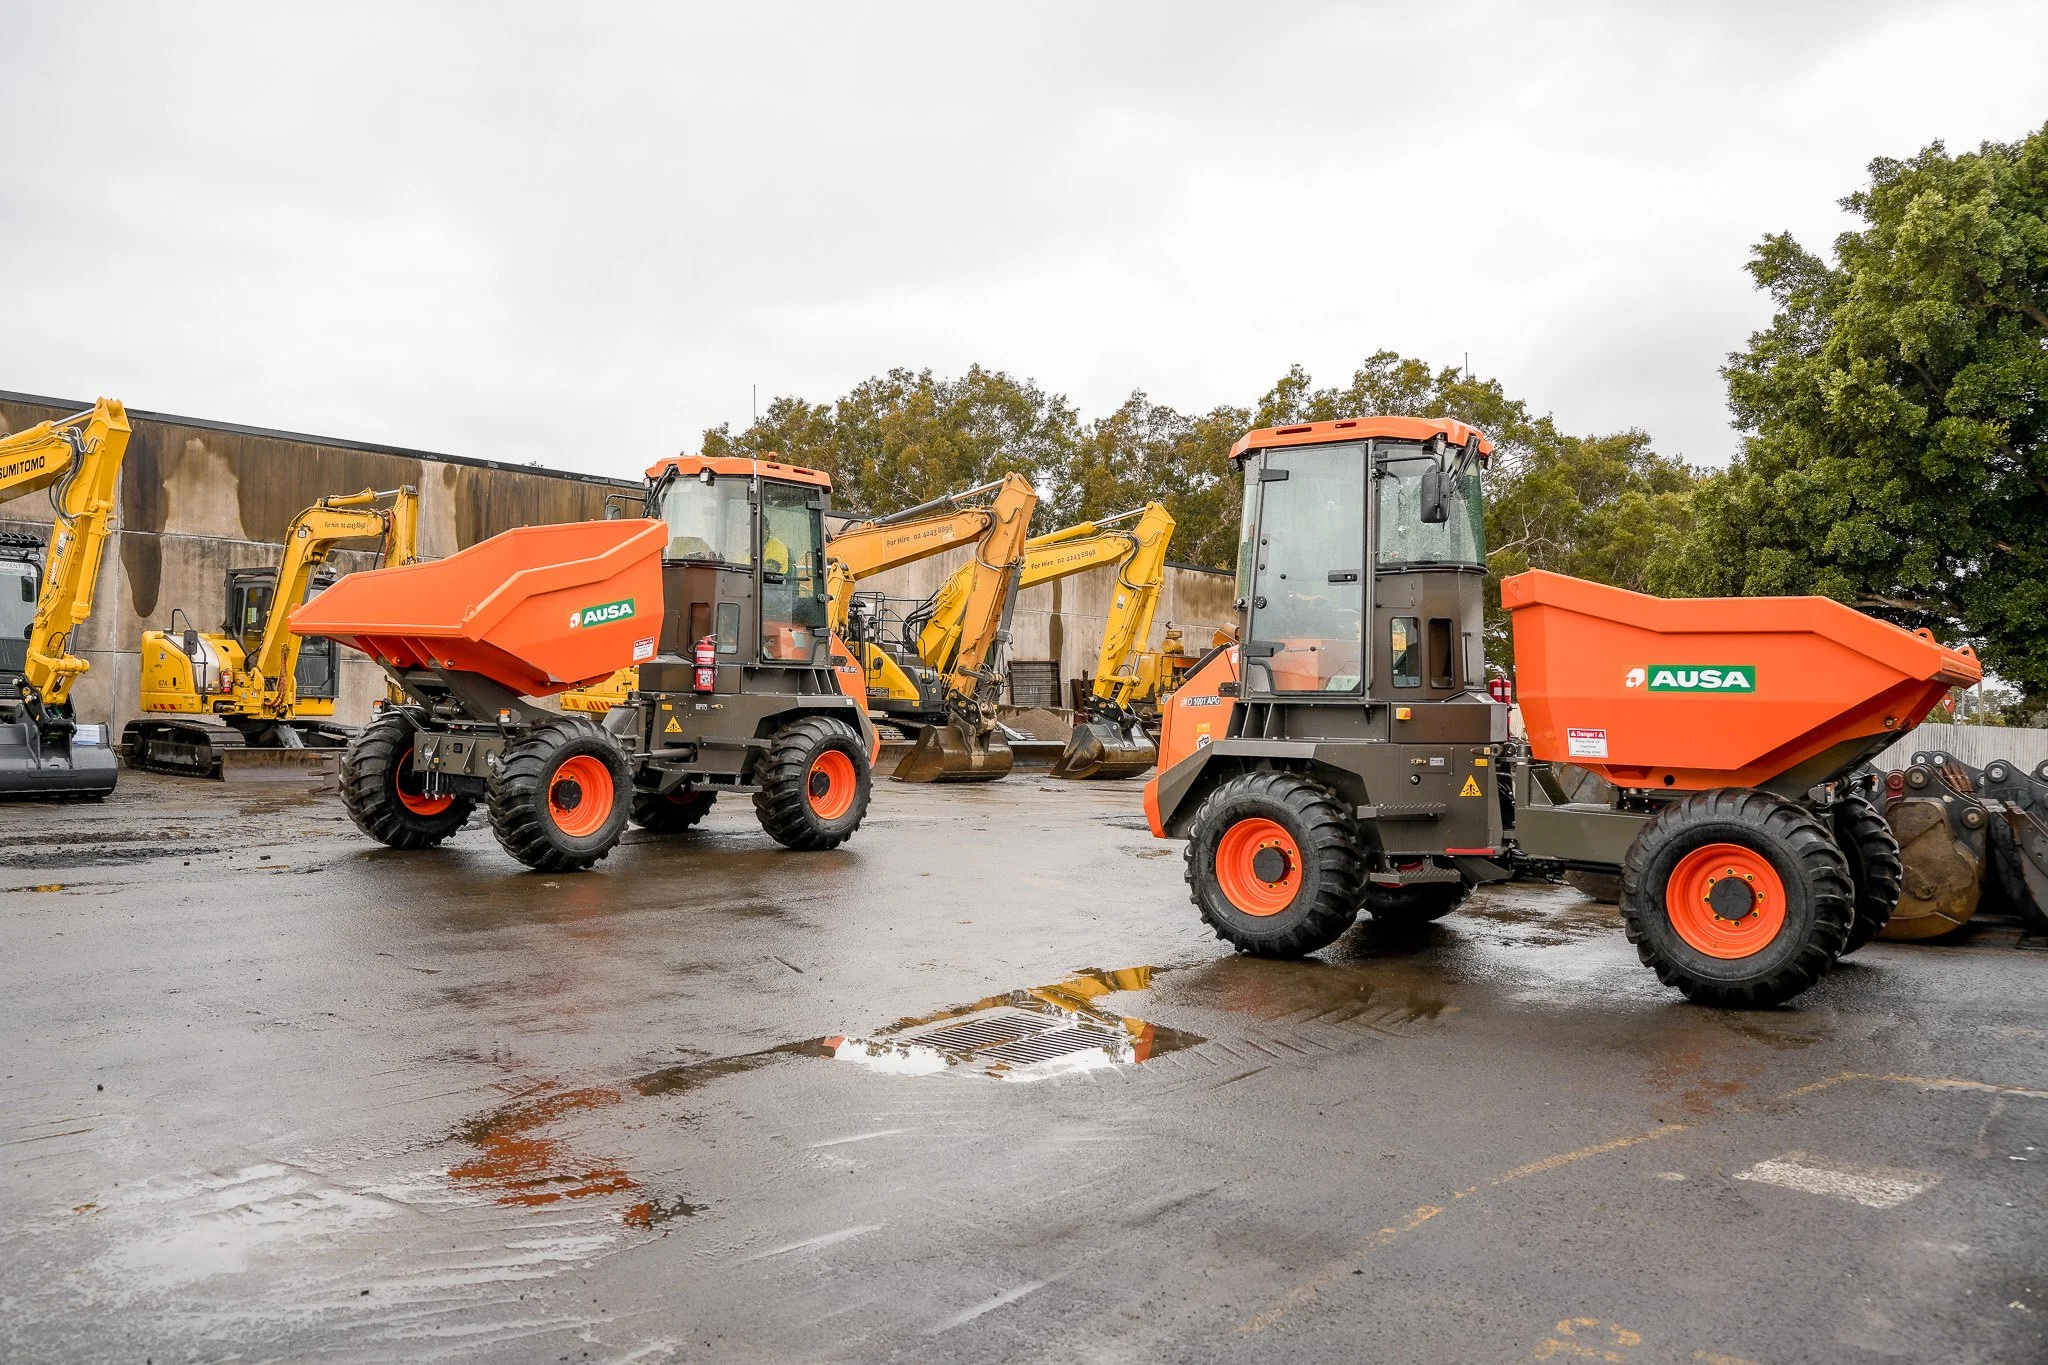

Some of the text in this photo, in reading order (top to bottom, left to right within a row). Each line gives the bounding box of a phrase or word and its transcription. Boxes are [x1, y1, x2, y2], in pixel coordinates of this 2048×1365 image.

[886, 539, 896, 547] For
[897, 536, 910, 545] Hire
[922, 529, 937, 539] 4243
[937, 524, 953, 533] 8898
[1066, 554, 1081, 562] 4243
[583, 603, 633, 625] AUSA
[1650, 669, 1751, 689] AUSA
[1187, 696, 1220, 706] D 1001 APG
[1576, 730, 1598, 738] Danger!
